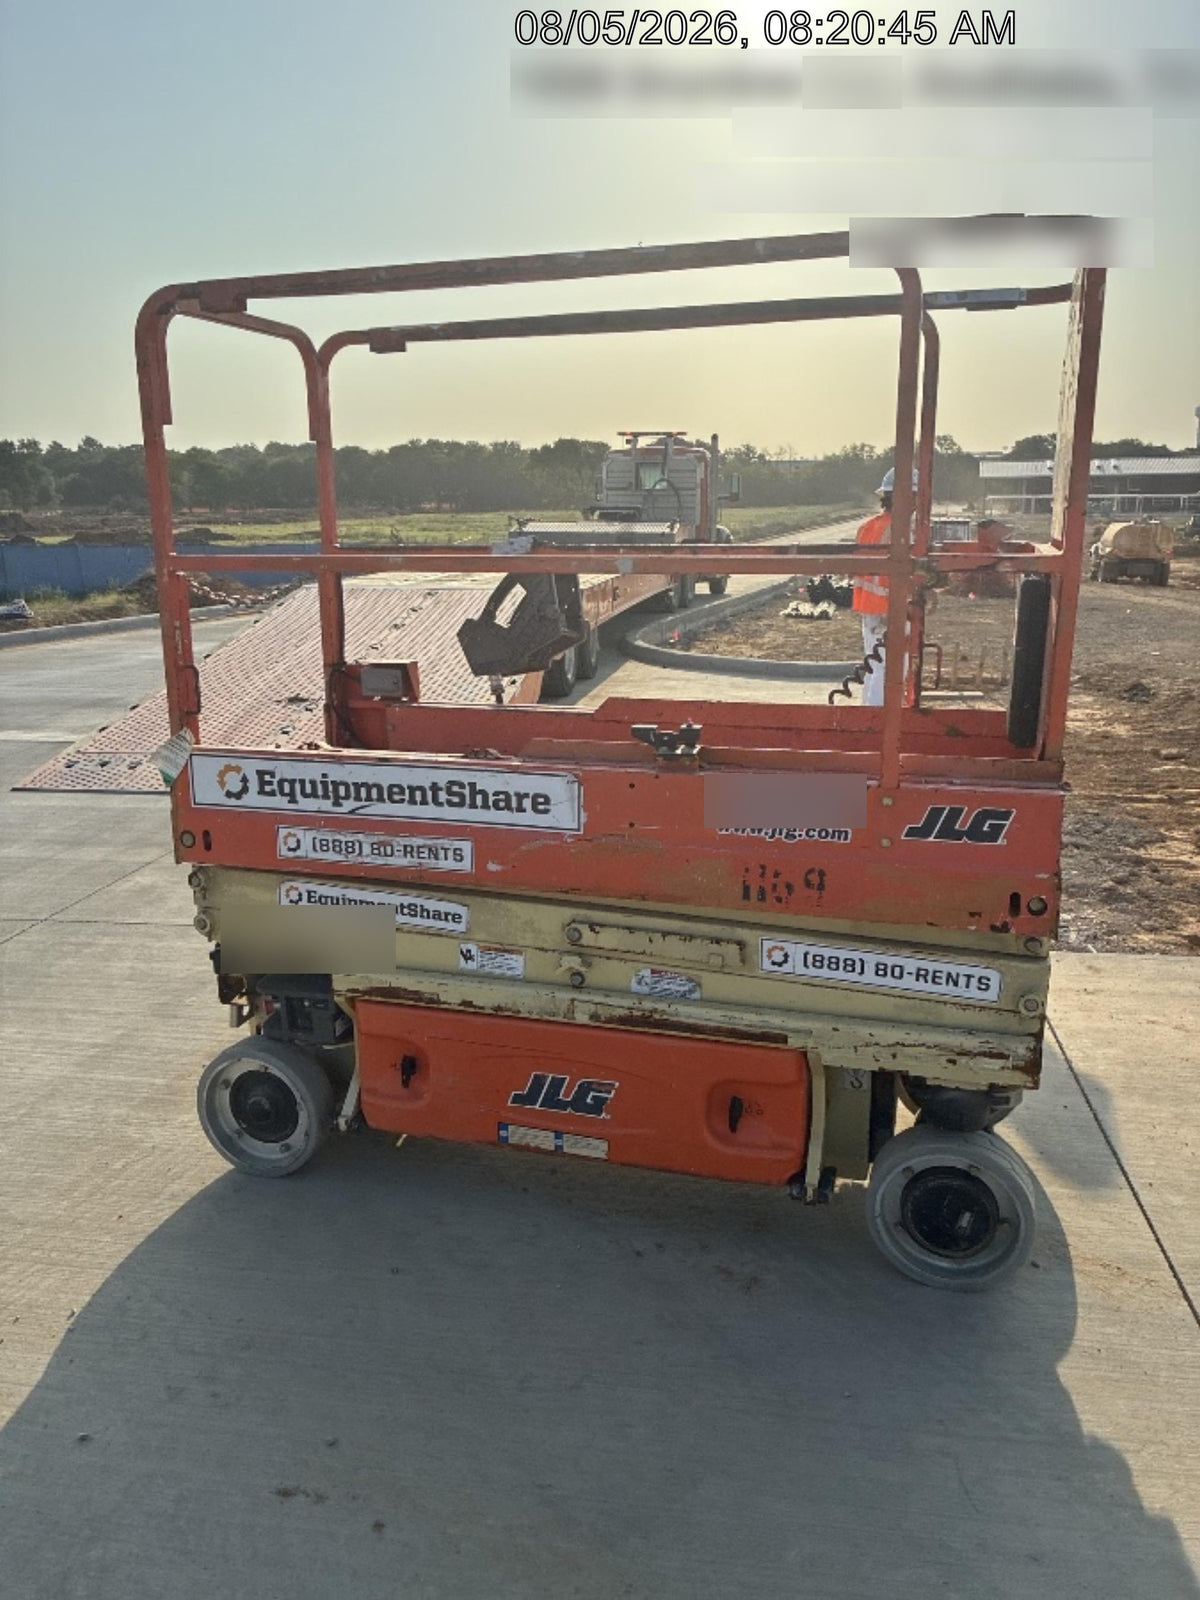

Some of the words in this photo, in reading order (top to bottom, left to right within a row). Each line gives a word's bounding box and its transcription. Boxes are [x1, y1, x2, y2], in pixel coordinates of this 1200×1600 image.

[256, 769, 552, 815] EquipmentShare
[901, 805, 1016, 845] JLG
[311, 836, 363, 857] (888)
[305, 889, 463, 925] EquitShare
[802, 951, 865, 976] (888)
[874, 962, 992, 992] 80-RENTS
[508, 1071, 619, 1118] JLG
